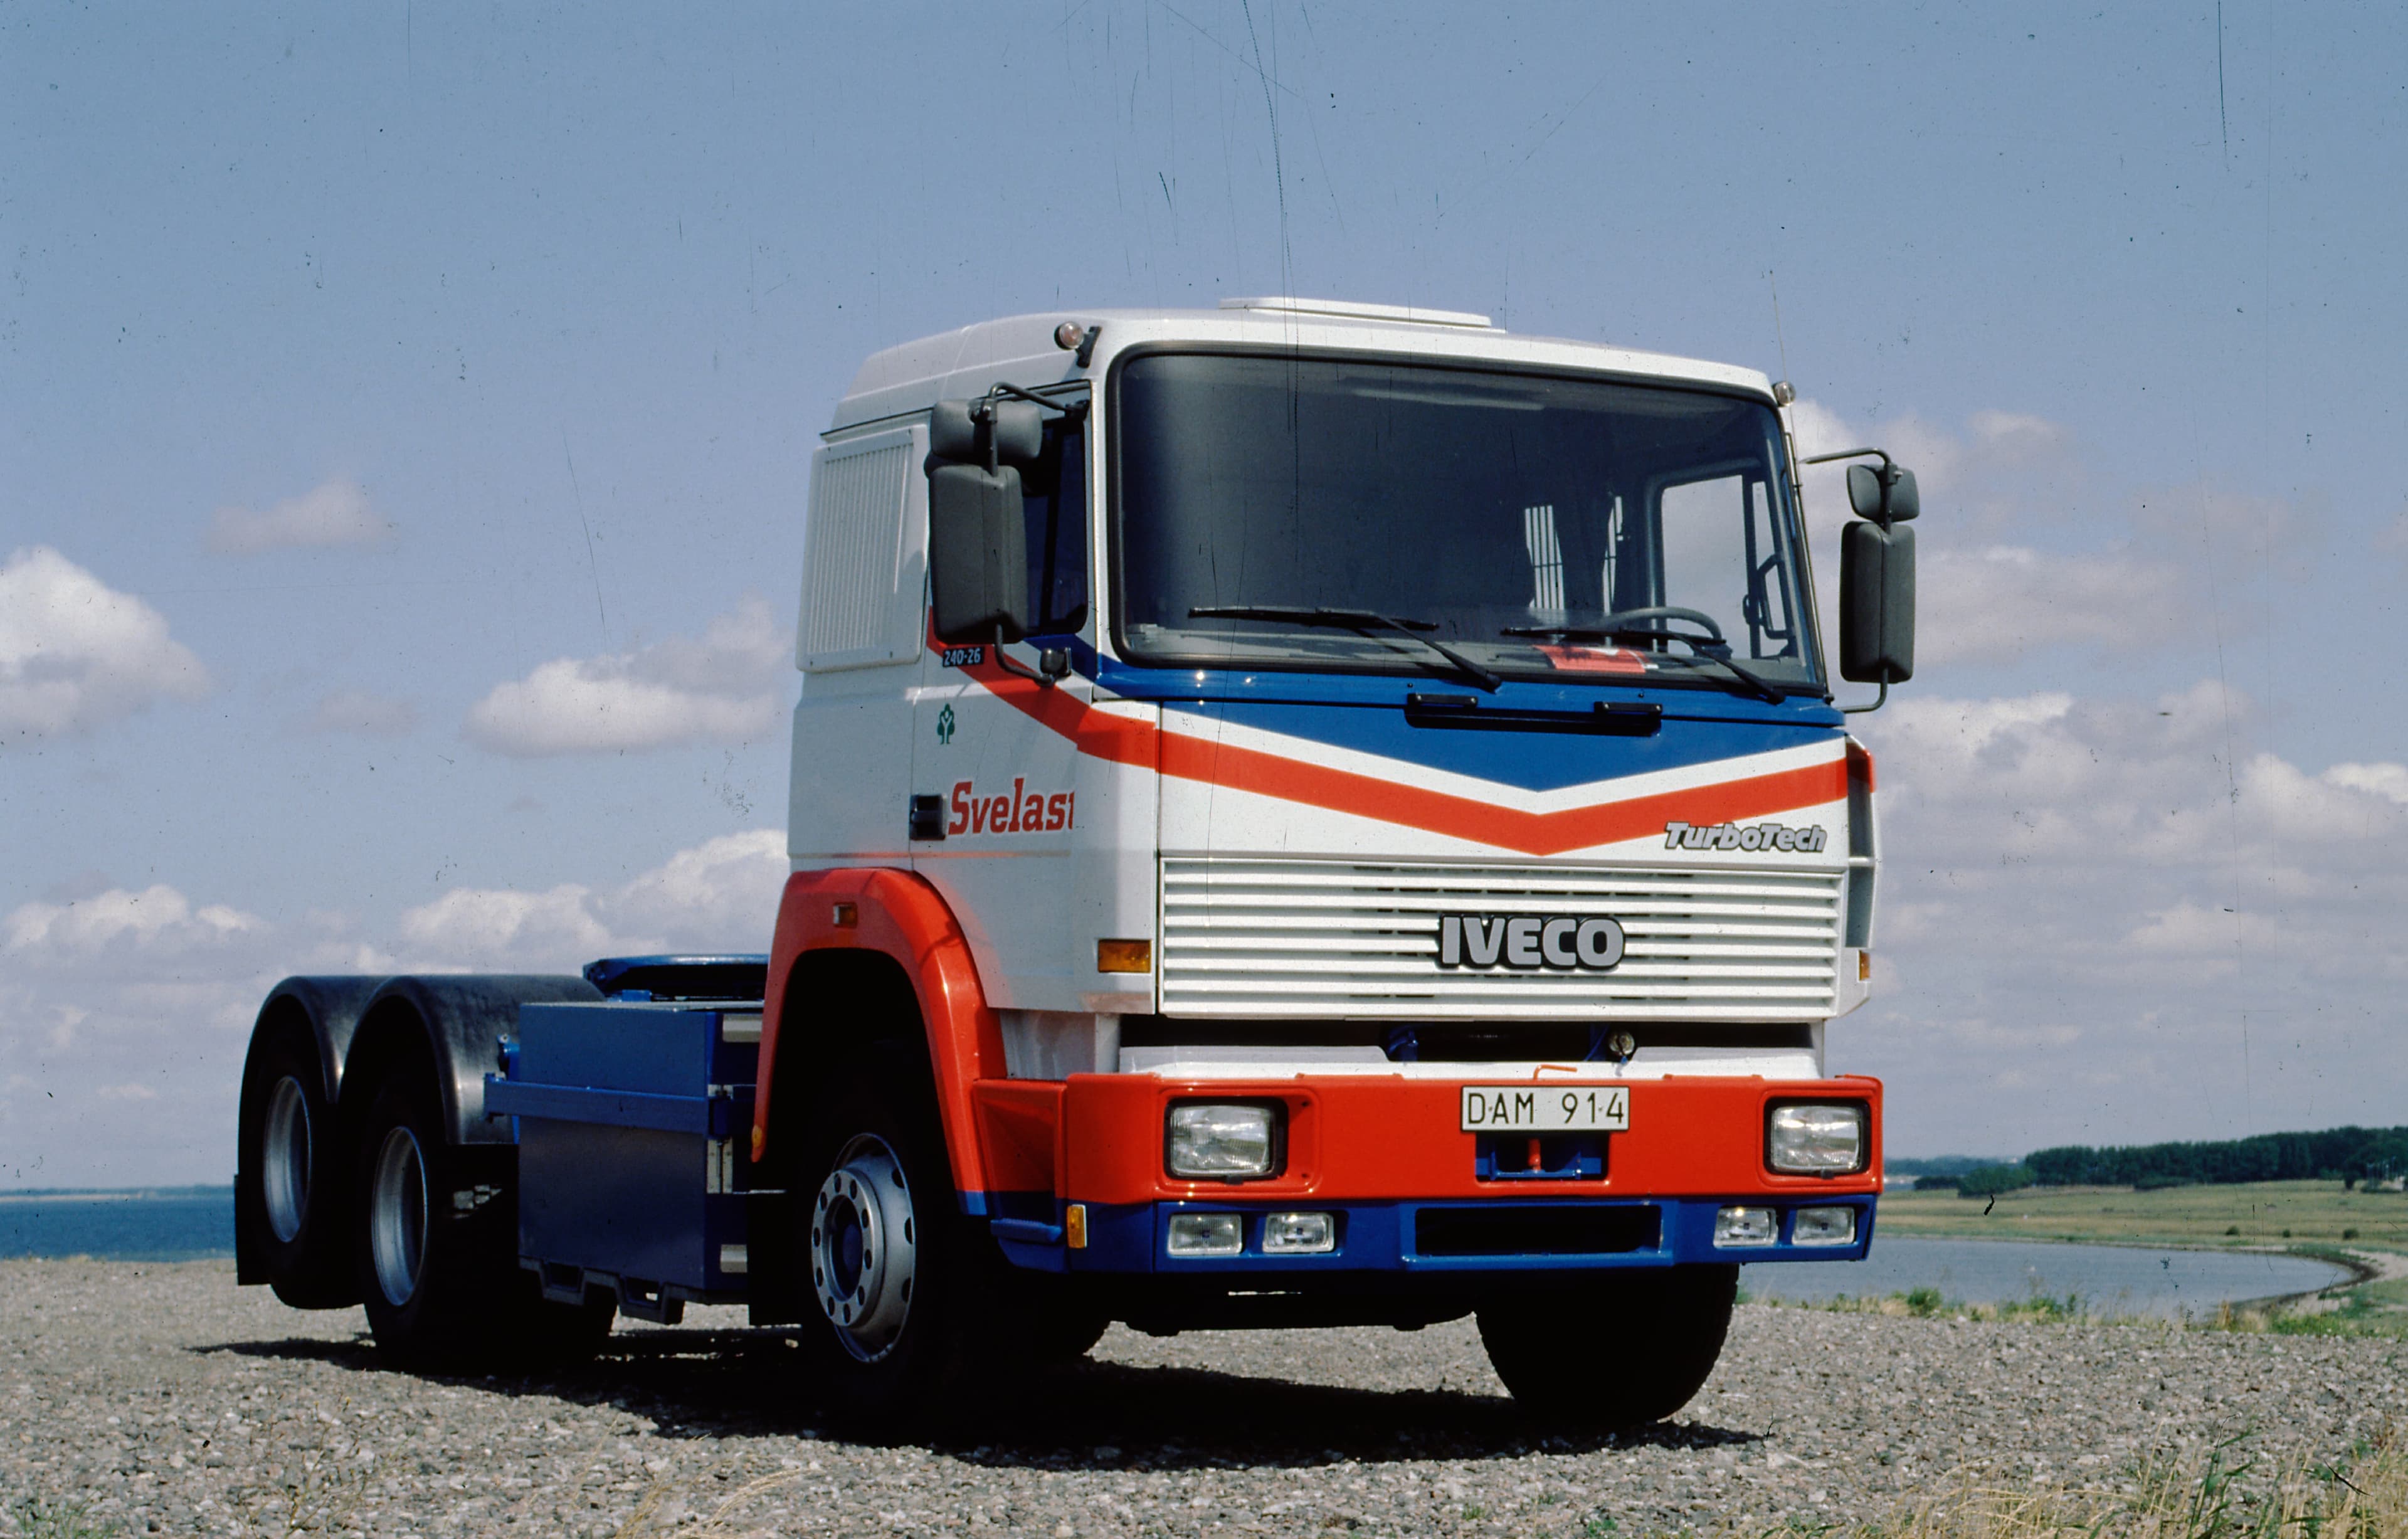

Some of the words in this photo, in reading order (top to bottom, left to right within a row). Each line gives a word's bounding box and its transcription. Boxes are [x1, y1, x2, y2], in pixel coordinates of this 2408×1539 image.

[1664, 821, 1827, 853] TurboTech
[1440, 915, 1625, 968] IVECO
[1468, 1092, 1534, 1124] DAM
[1561, 1092, 1624, 1124] 914
